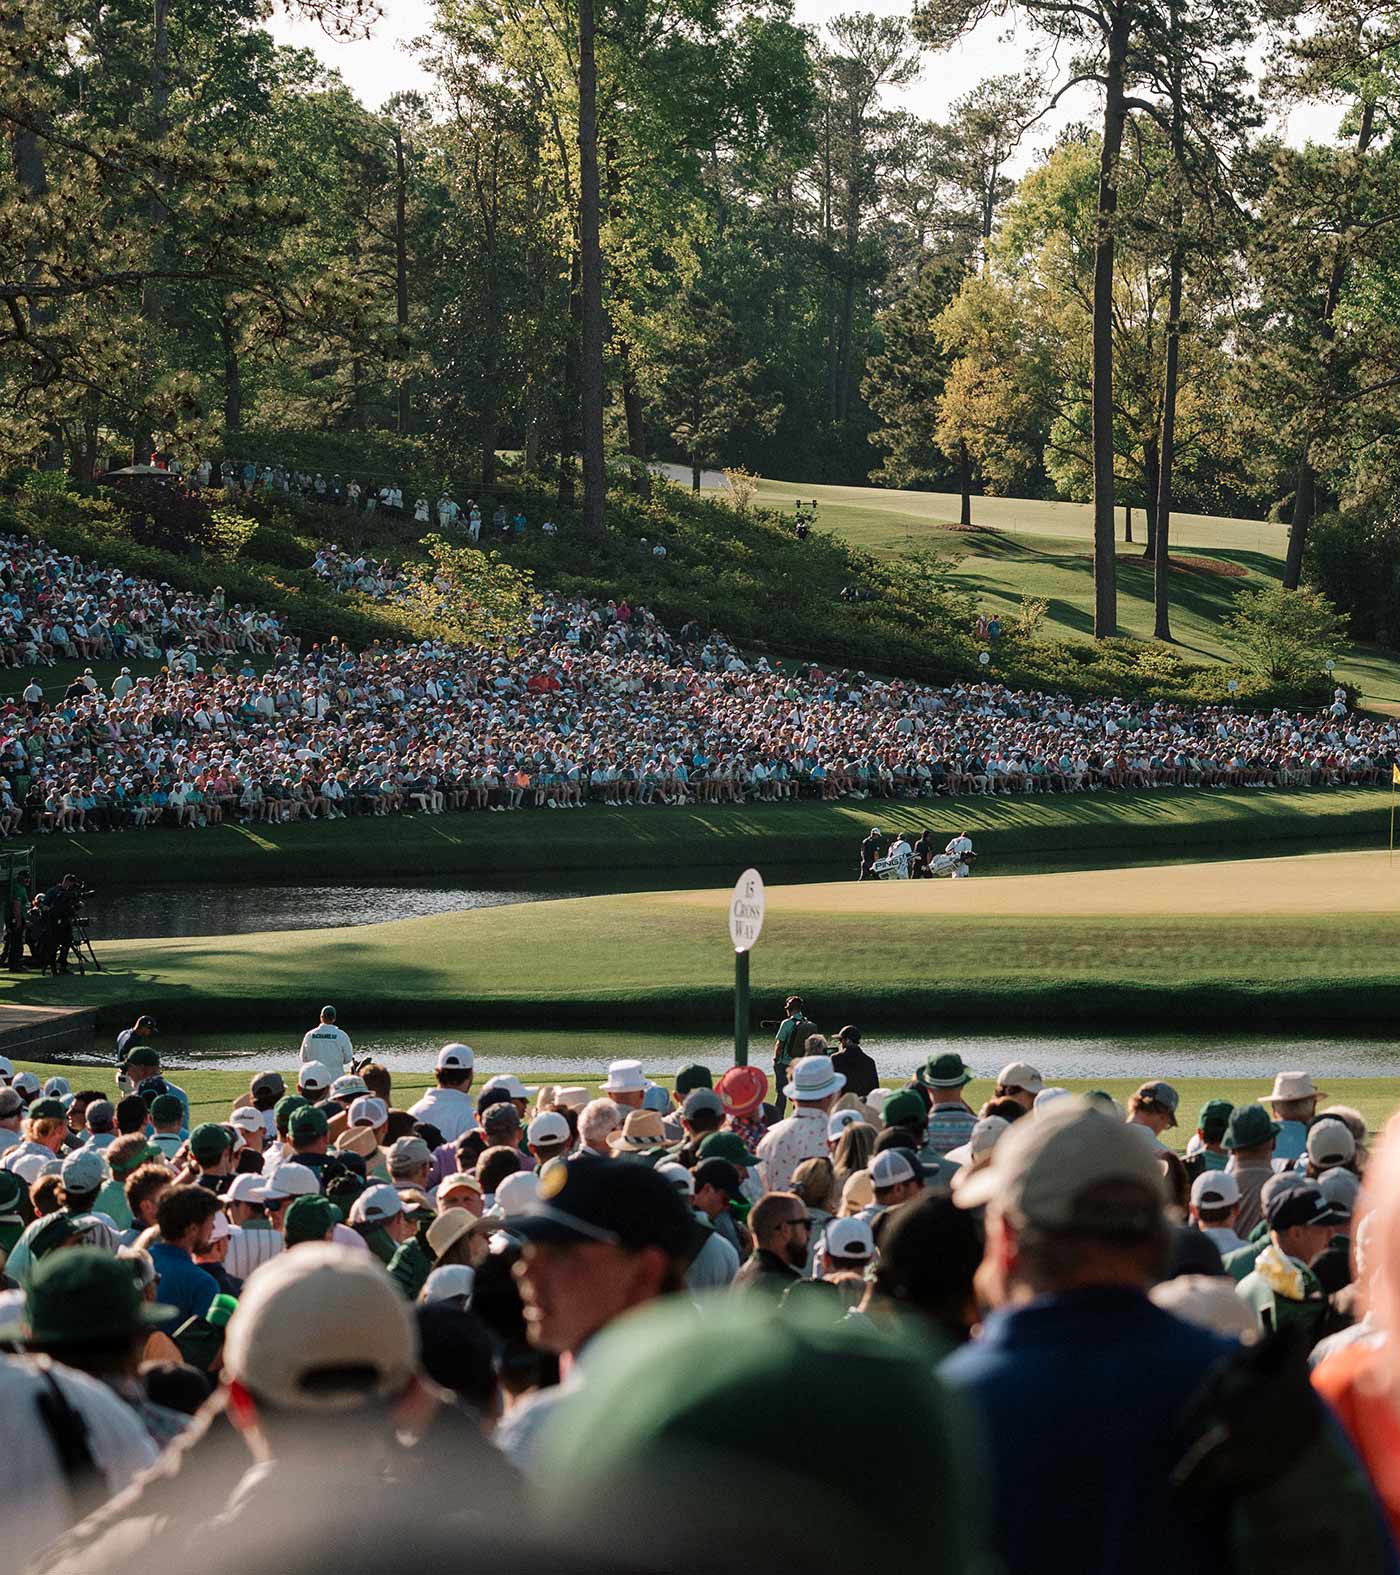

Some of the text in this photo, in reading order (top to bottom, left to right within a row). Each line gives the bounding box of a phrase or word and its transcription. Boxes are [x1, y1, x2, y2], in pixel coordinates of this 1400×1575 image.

[745, 881, 754, 898] 15
[734, 900, 760, 918] CROSS
[735, 920, 756, 940] WAY
